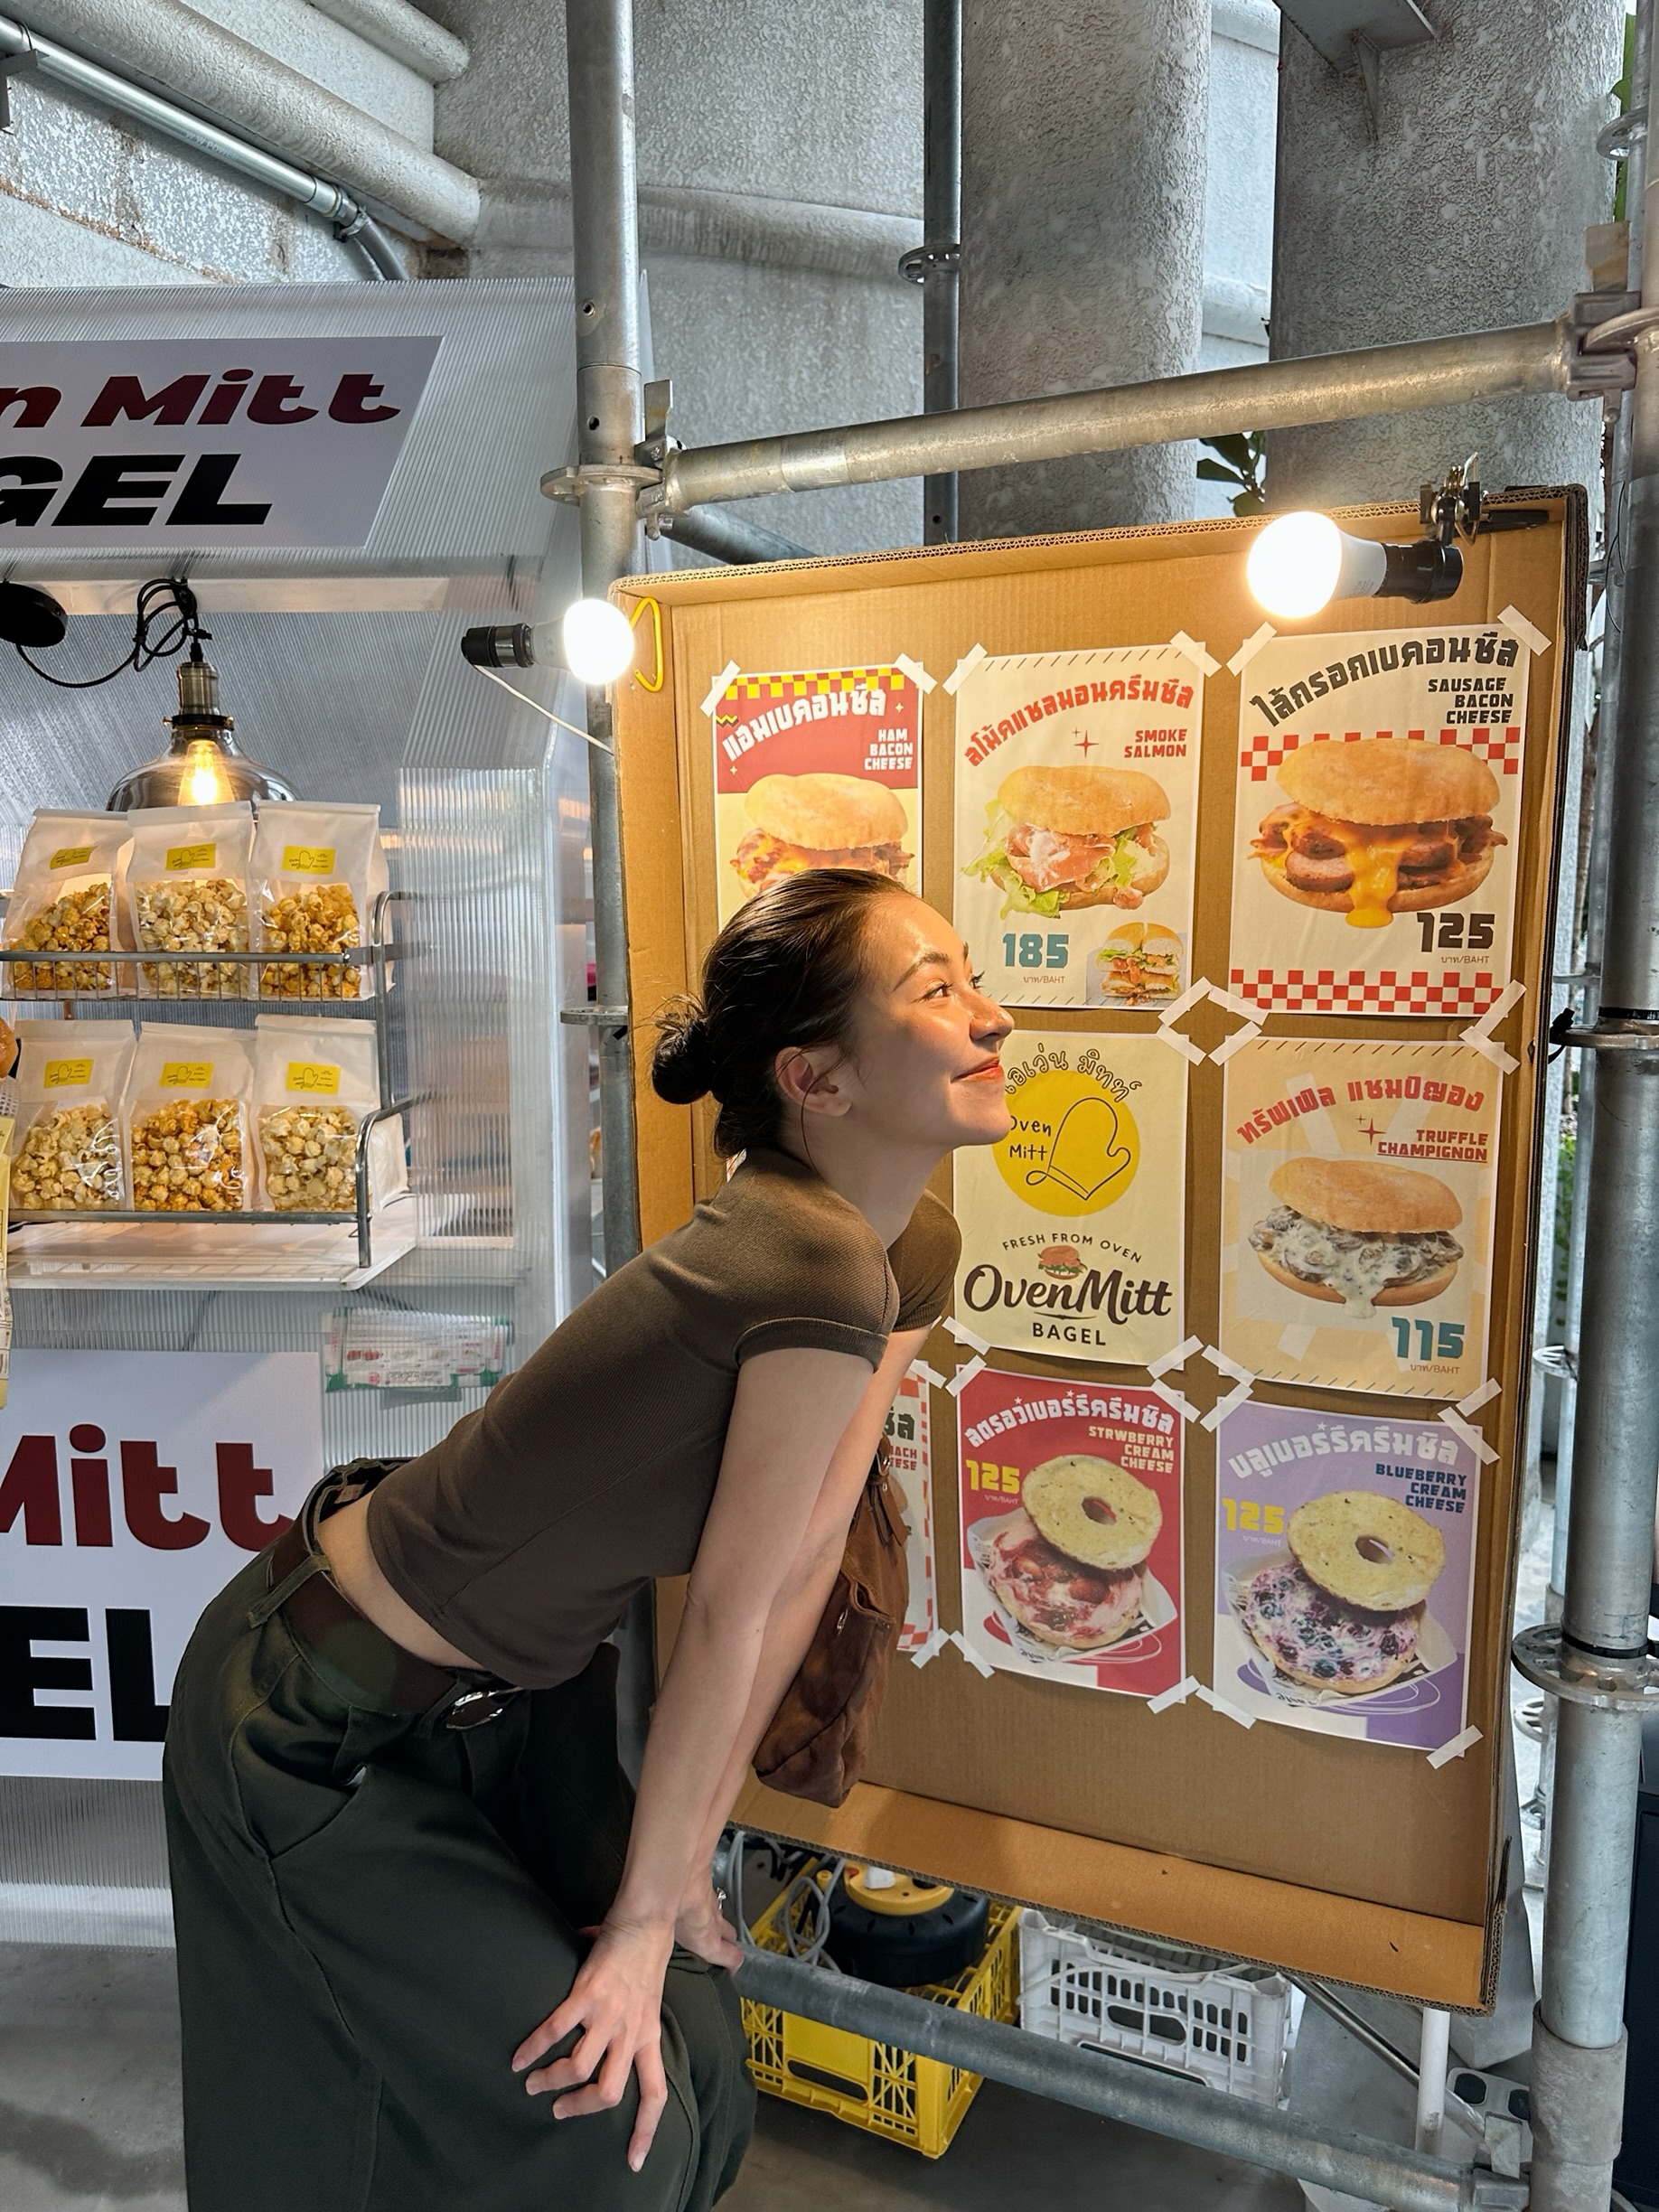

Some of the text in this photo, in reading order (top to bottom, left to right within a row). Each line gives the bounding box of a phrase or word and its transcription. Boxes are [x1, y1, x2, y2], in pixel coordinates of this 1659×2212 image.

[80, 369, 400, 426] Mitt
[1428, 677, 1507, 692] SAUSAGE
[1455, 693, 1514, 708] BACON
[1446, 709, 1513, 724] CHEESE
[877, 727, 908, 742] HAM
[1135, 728, 1187, 743] SMOKE
[869, 742, 914, 756] BACON
[1124, 744, 1186, 758] SALMON
[864, 756, 914, 771] CHEESE
[1417, 912, 1495, 952] 125
[1002, 933, 1070, 970] 185
[1416, 1129, 1488, 1147] TRUFFLE
[1009, 1143, 1047, 1161] Mitt
[1377, 1141, 1488, 1162] CHAMPIGNON
[1002, 1233, 1142, 1263] FRESH FROM OVEN
[1033, 1322, 1106, 1346] BAGEL
[1392, 1317, 1465, 1361] 115
[1089, 1425, 1174, 1448] STRWBERRY
[1124, 1444, 1175, 1461] CREAM
[1120, 1456, 1174, 1474] CHEESE
[965, 1459, 1020, 1495] 125
[1375, 1463, 1467, 1486] BLUEBERRY
[1410, 1482, 1467, 1500] CREAM
[1405, 1495, 1466, 1514] CHEESE
[1222, 1497, 1285, 1535] 125
